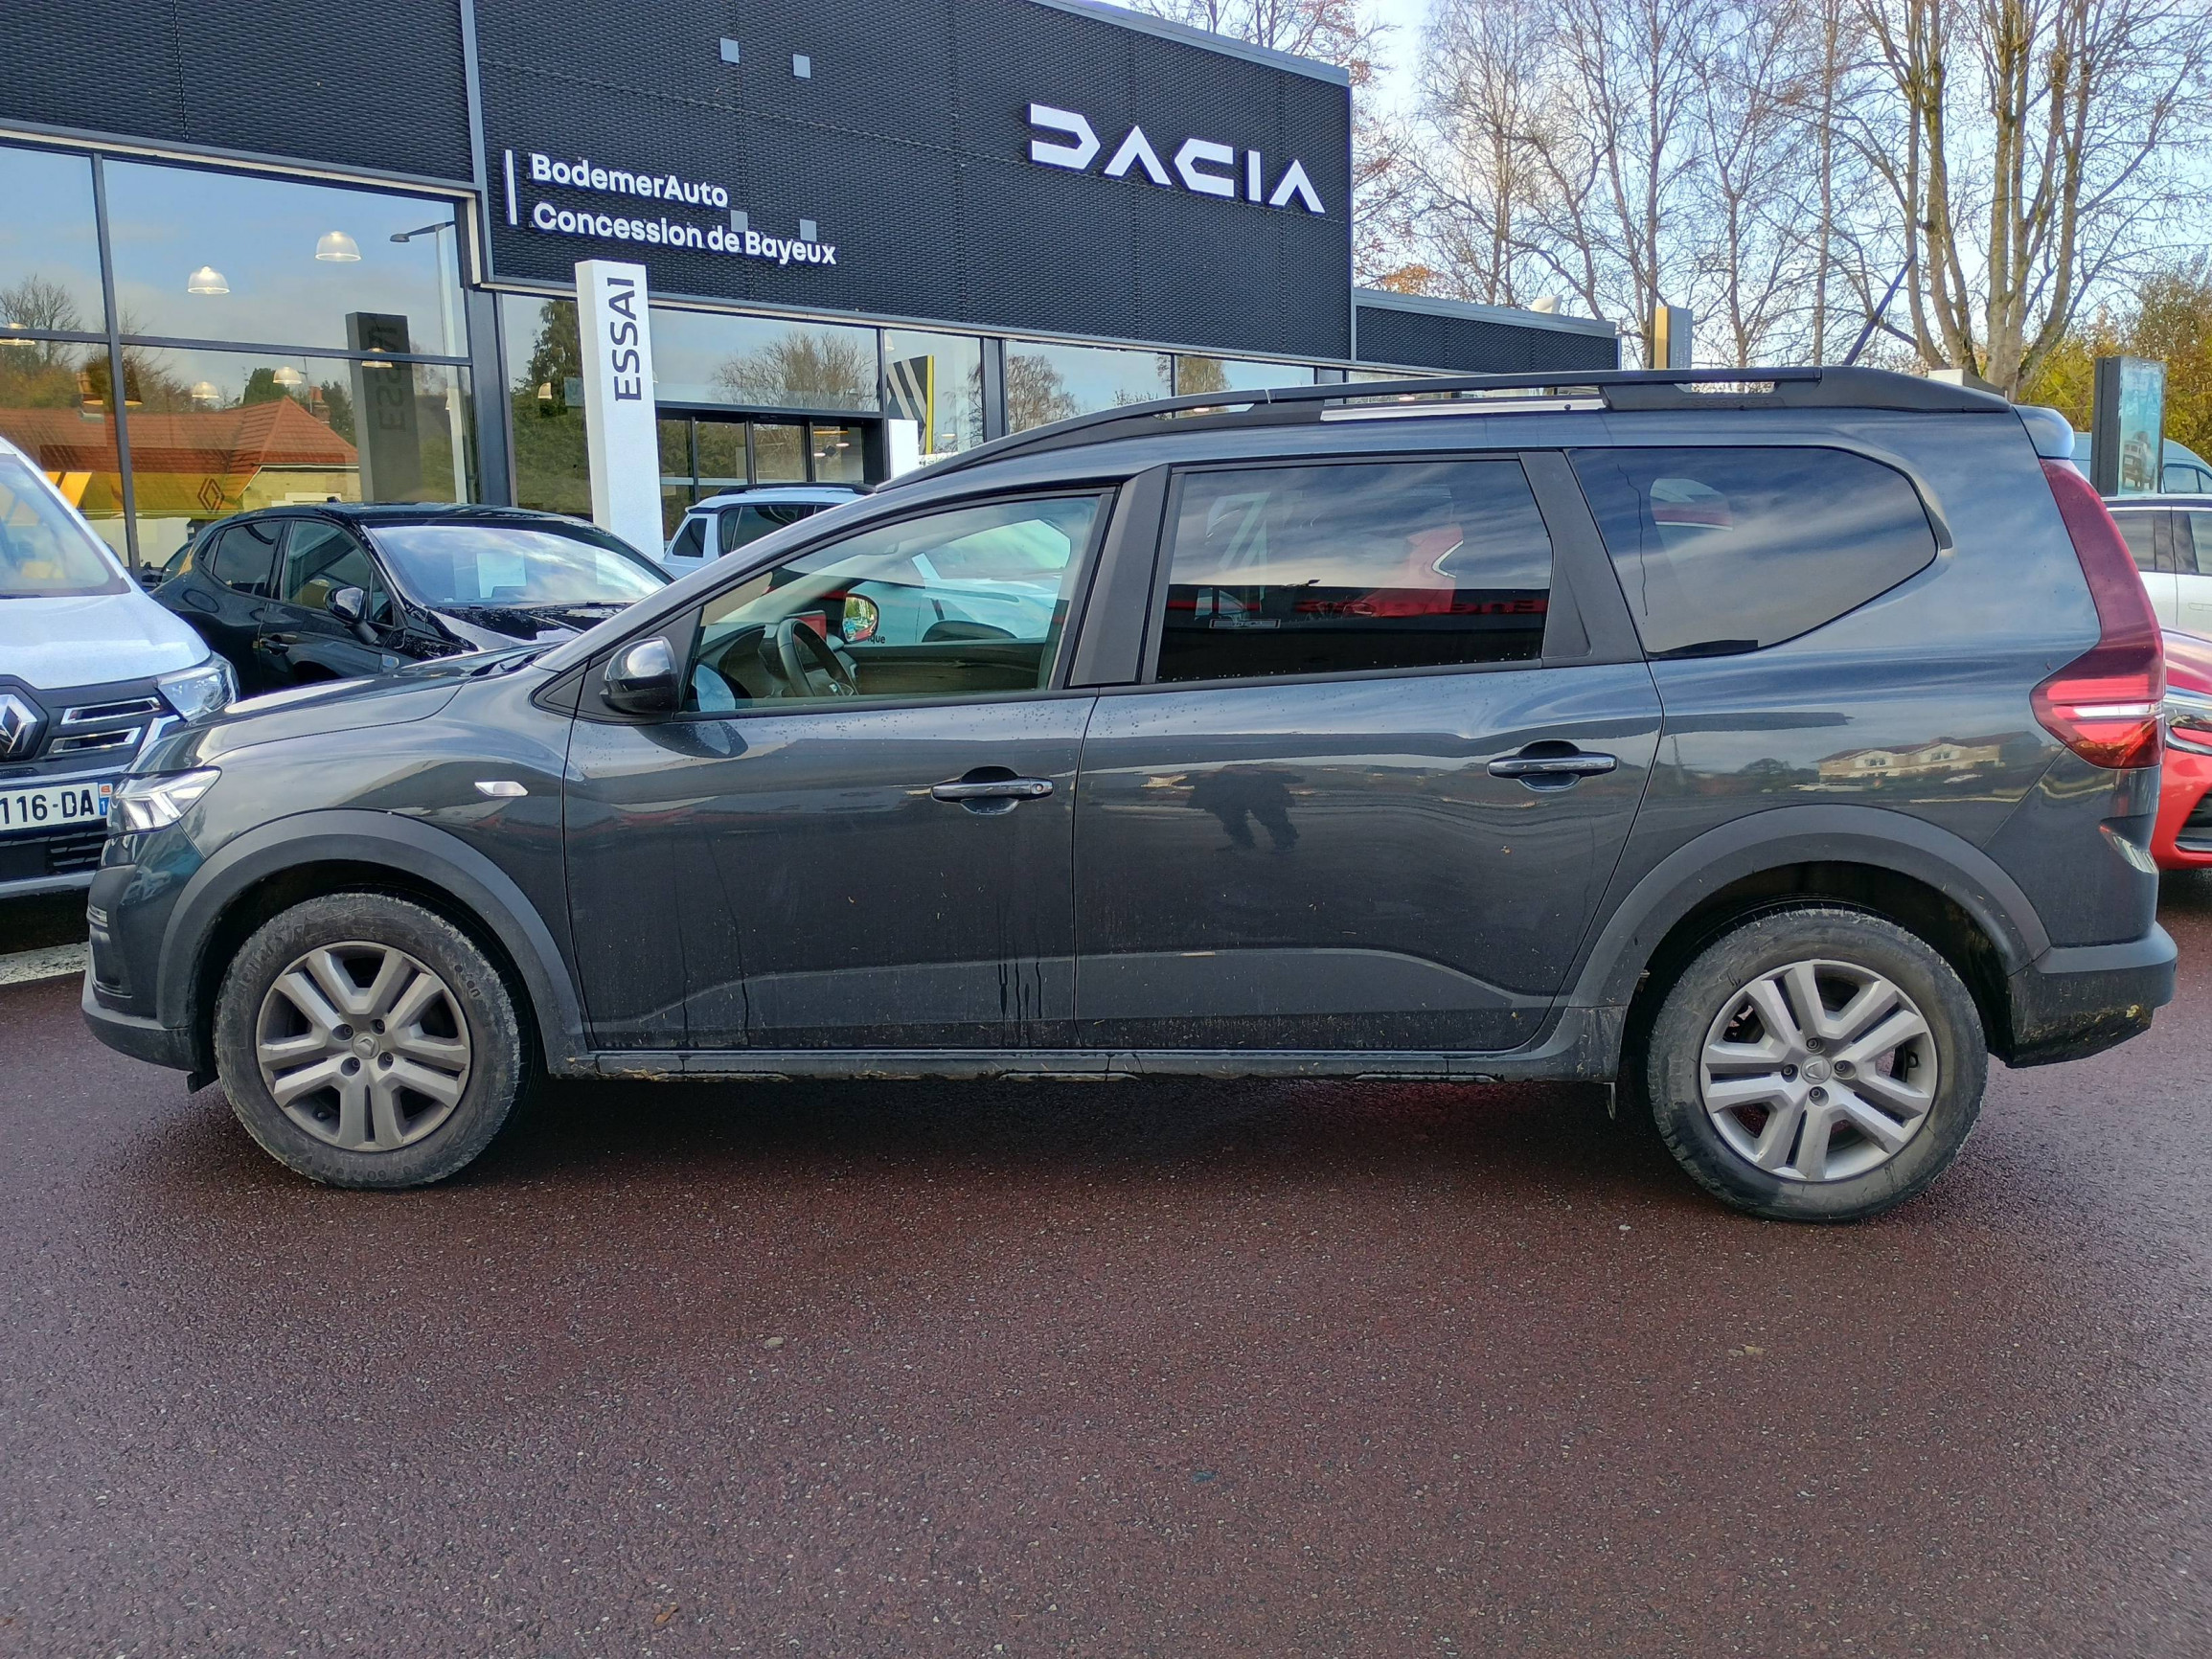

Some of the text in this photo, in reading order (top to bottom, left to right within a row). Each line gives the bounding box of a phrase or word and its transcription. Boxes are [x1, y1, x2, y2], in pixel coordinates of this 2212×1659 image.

[531, 152, 728, 208] BodemerAuto
[1030, 102, 1326, 214] DACIA
[534, 202, 836, 265] Concession de Bayeux
[607, 277, 642, 401] ESSAI
